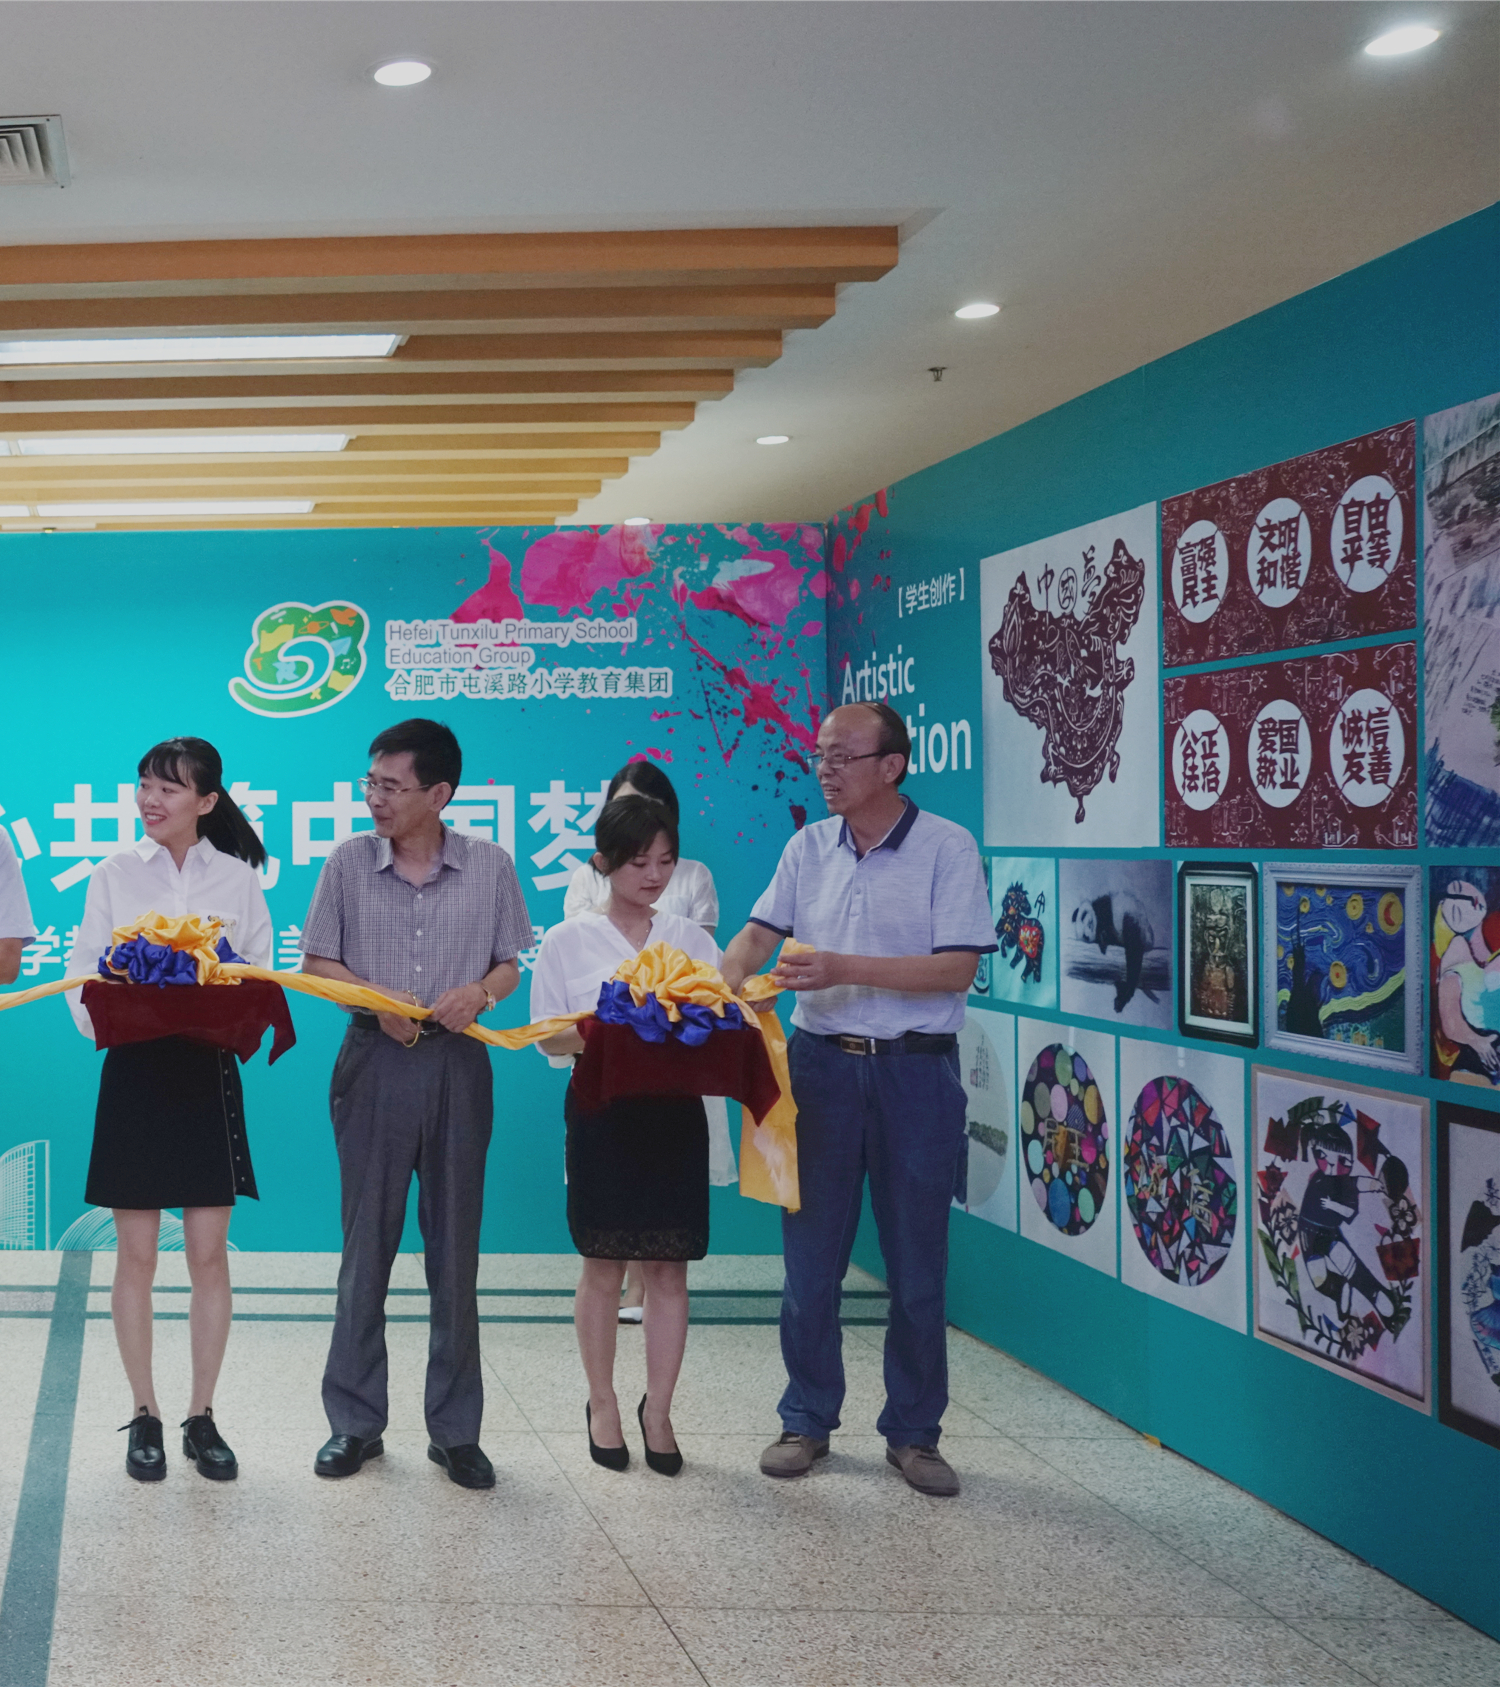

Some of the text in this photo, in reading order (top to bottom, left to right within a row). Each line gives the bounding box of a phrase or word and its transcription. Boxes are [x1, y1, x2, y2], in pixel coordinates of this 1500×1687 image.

[389, 621, 634, 644] Hefei Tunxilu Primary School
[389, 648, 532, 669] Education Group
[389, 671, 670, 697] 合肥市屯溪路小学教育集团
[842, 645, 915, 705] Artistic
